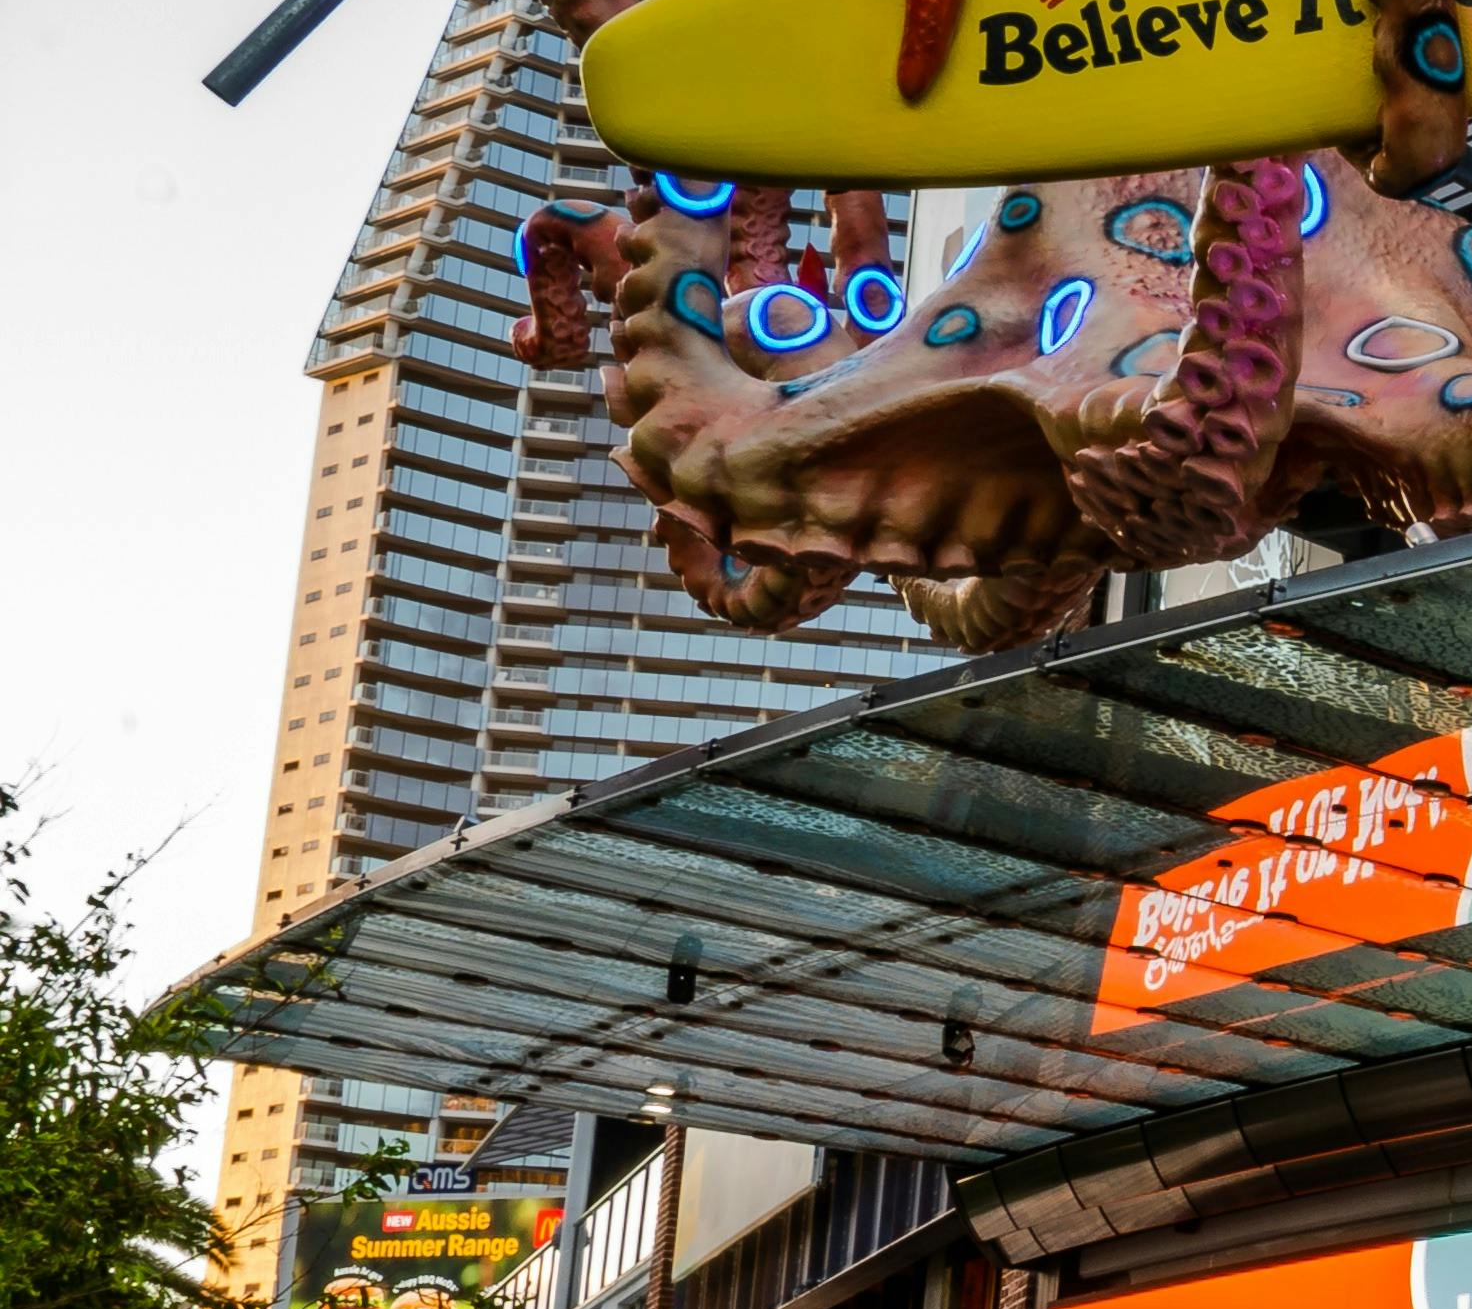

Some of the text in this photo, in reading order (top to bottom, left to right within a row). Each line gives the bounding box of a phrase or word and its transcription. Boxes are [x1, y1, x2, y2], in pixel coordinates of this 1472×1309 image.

[385, 1206, 492, 1232] NEW Aussie
[350, 1233, 519, 1262] Summer Range
